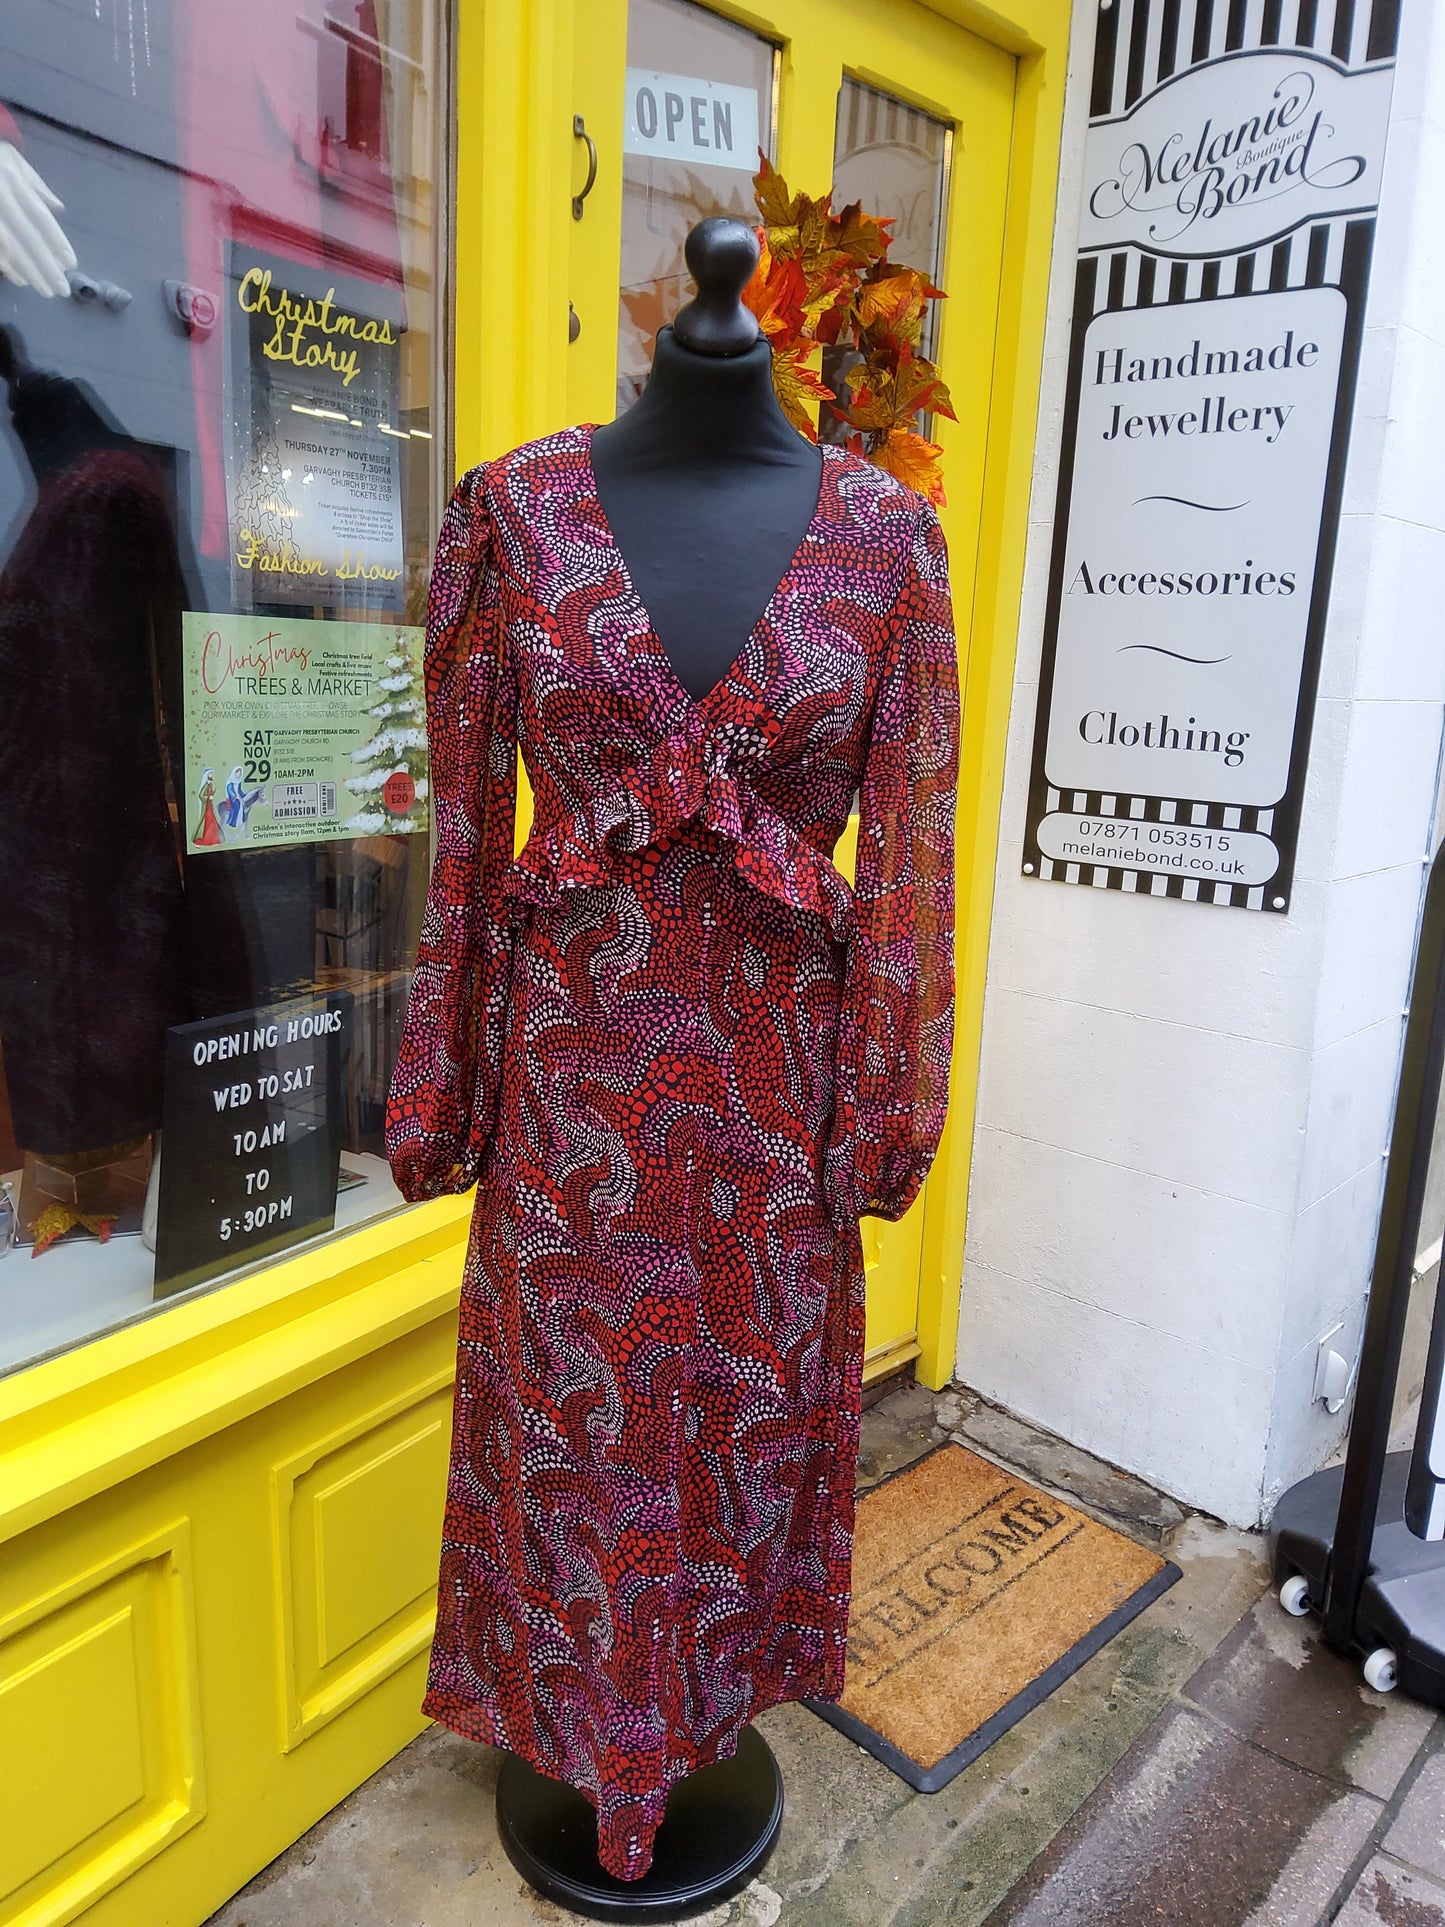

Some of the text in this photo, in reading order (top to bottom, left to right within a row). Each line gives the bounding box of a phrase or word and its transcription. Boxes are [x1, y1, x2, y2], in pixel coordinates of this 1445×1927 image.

[635, 85, 734, 151] OPEN
[1090, 71, 1315, 218] Melanie
[1236, 128, 1308, 169] Boutique
[1149, 110, 1366, 241] Bond
[238, 267, 396, 346] Christmas
[264, 314, 361, 386] Story
[1092, 330, 1320, 386] Handmade
[353, 395, 378, 407] BOND
[360, 407, 388, 420] TRUTH
[1102, 395, 1295, 444] Jewellery
[285, 440, 391, 465] THURSDAY 27TH NOVEMBER
[304, 465, 392, 484] GARVAGHY PRESBYTERIAN
[361, 463, 391, 475] 7.30PM
[331, 478, 360, 489] CHURCH
[361, 482, 377, 492] BT32
[350, 489, 377, 500] TICKETS
[236, 529, 329, 576] Fashion
[1065, 559, 1296, 597] Accessories
[202, 631, 312, 694] Christmas
[234, 677, 372, 696] TREES & MARKET
[220, 710, 250, 719] MARKET
[252, 711, 257, 719] &
[259, 710, 289, 719] EXPLORE
[289, 710, 302, 719] THE
[303, 710, 339, 719] CHRISTMAS
[341, 710, 361, 718] STORY
[221, 701, 243, 710] YOUR
[245, 701, 263, 710] OWN
[243, 730, 273, 746] SAT
[1078, 710, 1250, 768] Clothing
[244, 746, 271, 759] NOV
[244, 760, 271, 783] 29
[274, 769, 315, 779] 10AM-2PM
[287, 786, 303, 796] FREE
[386, 782, 412, 791] TREES
[392, 793, 408, 804] £20
[274, 806, 316, 818] ADMISSION
[252, 832, 283, 840] Christmas
[284, 830, 300, 838] story
[317, 827, 332, 836] 12pm
[338, 826, 350, 834] 1pm
[253, 819, 340, 832] Children's interactive outdoor
[1079, 820, 1231, 853] 07871 053515
[1062, 840, 1245, 875] melaniebond.co.uk
[193, 1009, 342, 1066] OPENING HOURS
[214, 1065, 315, 1113] WED TO SAT
[245, 1169, 269, 1195] TO
[219, 1196, 293, 1241] 5:30PM
